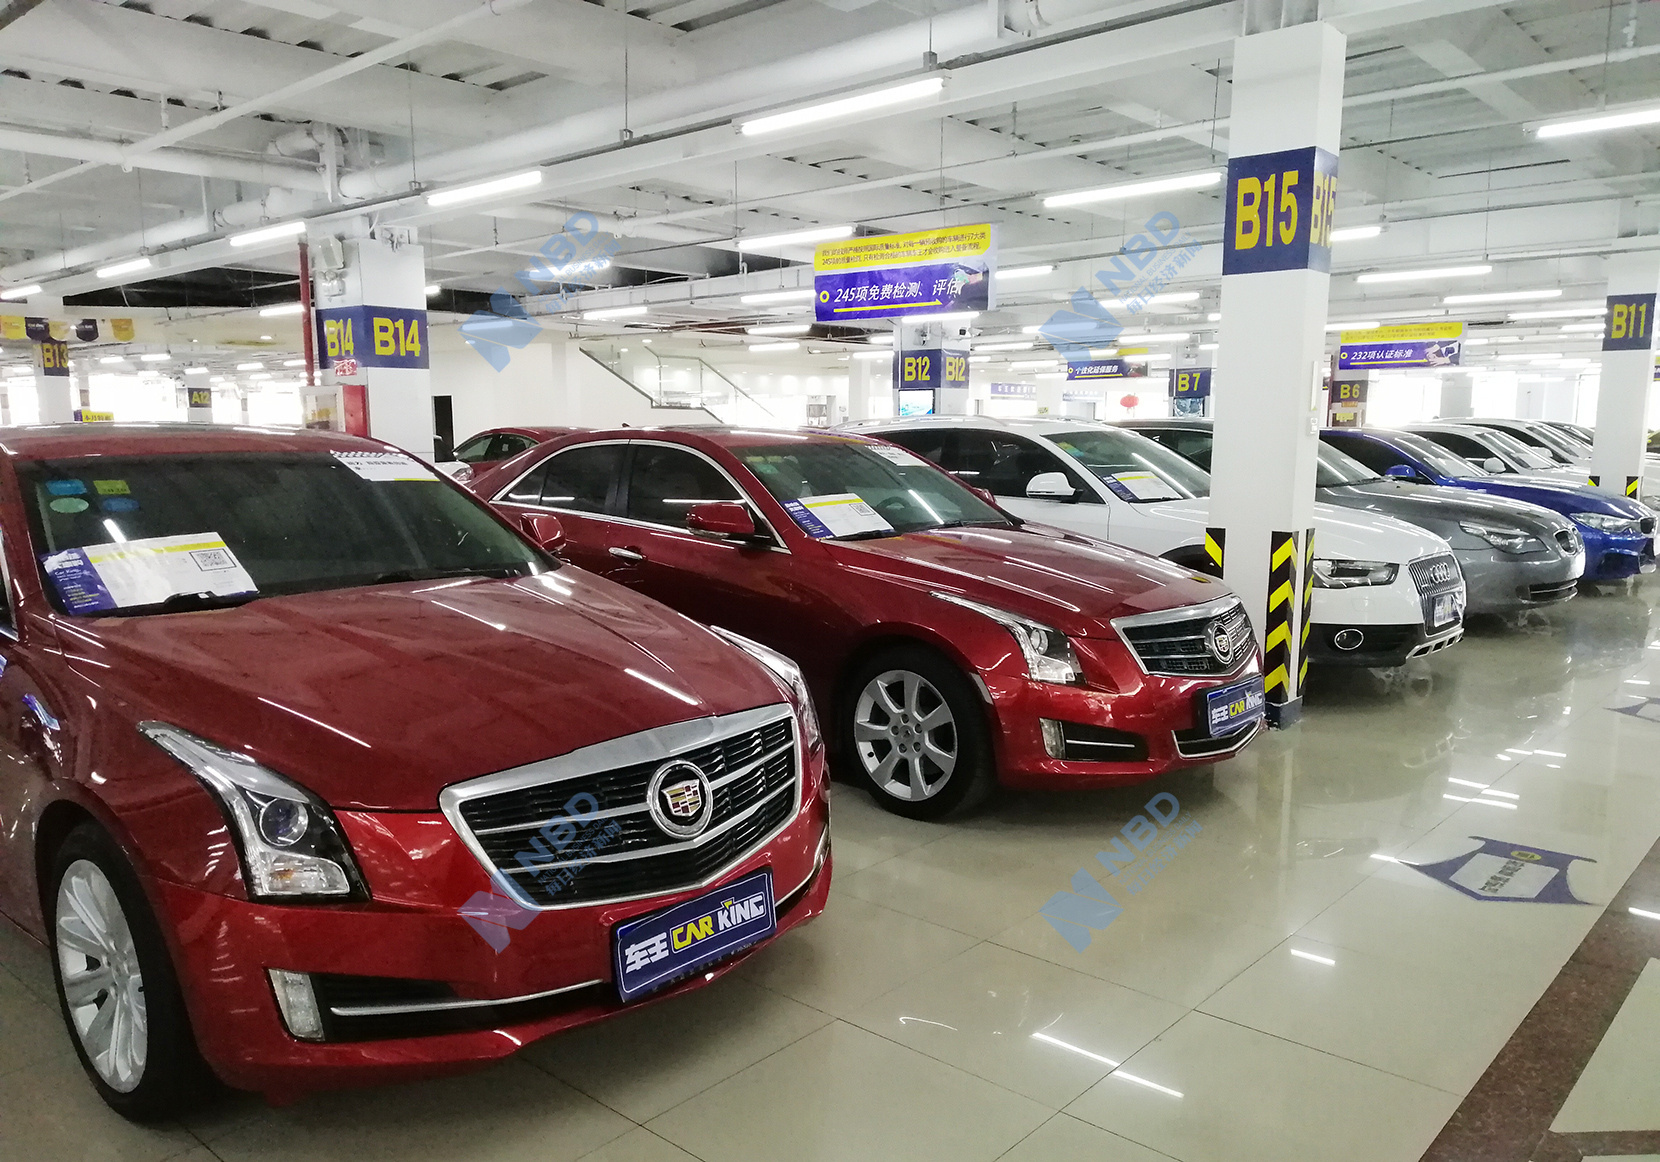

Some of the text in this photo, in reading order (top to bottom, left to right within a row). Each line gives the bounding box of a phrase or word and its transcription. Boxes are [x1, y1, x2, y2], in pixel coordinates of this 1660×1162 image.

[1235, 170, 1299, 250] B15
[1310, 171, 1337, 248] B15
[324, 318, 354, 357] B14
[373, 317, 421, 357] B14
[1611, 303, 1647, 339] B11
[42, 343, 69, 368] B13
[904, 356, 931, 381] B12
[945, 356, 966, 381] B12
[1229, 700, 1245, 716] CAR
[672, 895, 765, 950] CAR KING
[625, 932, 669, 974] 车王
